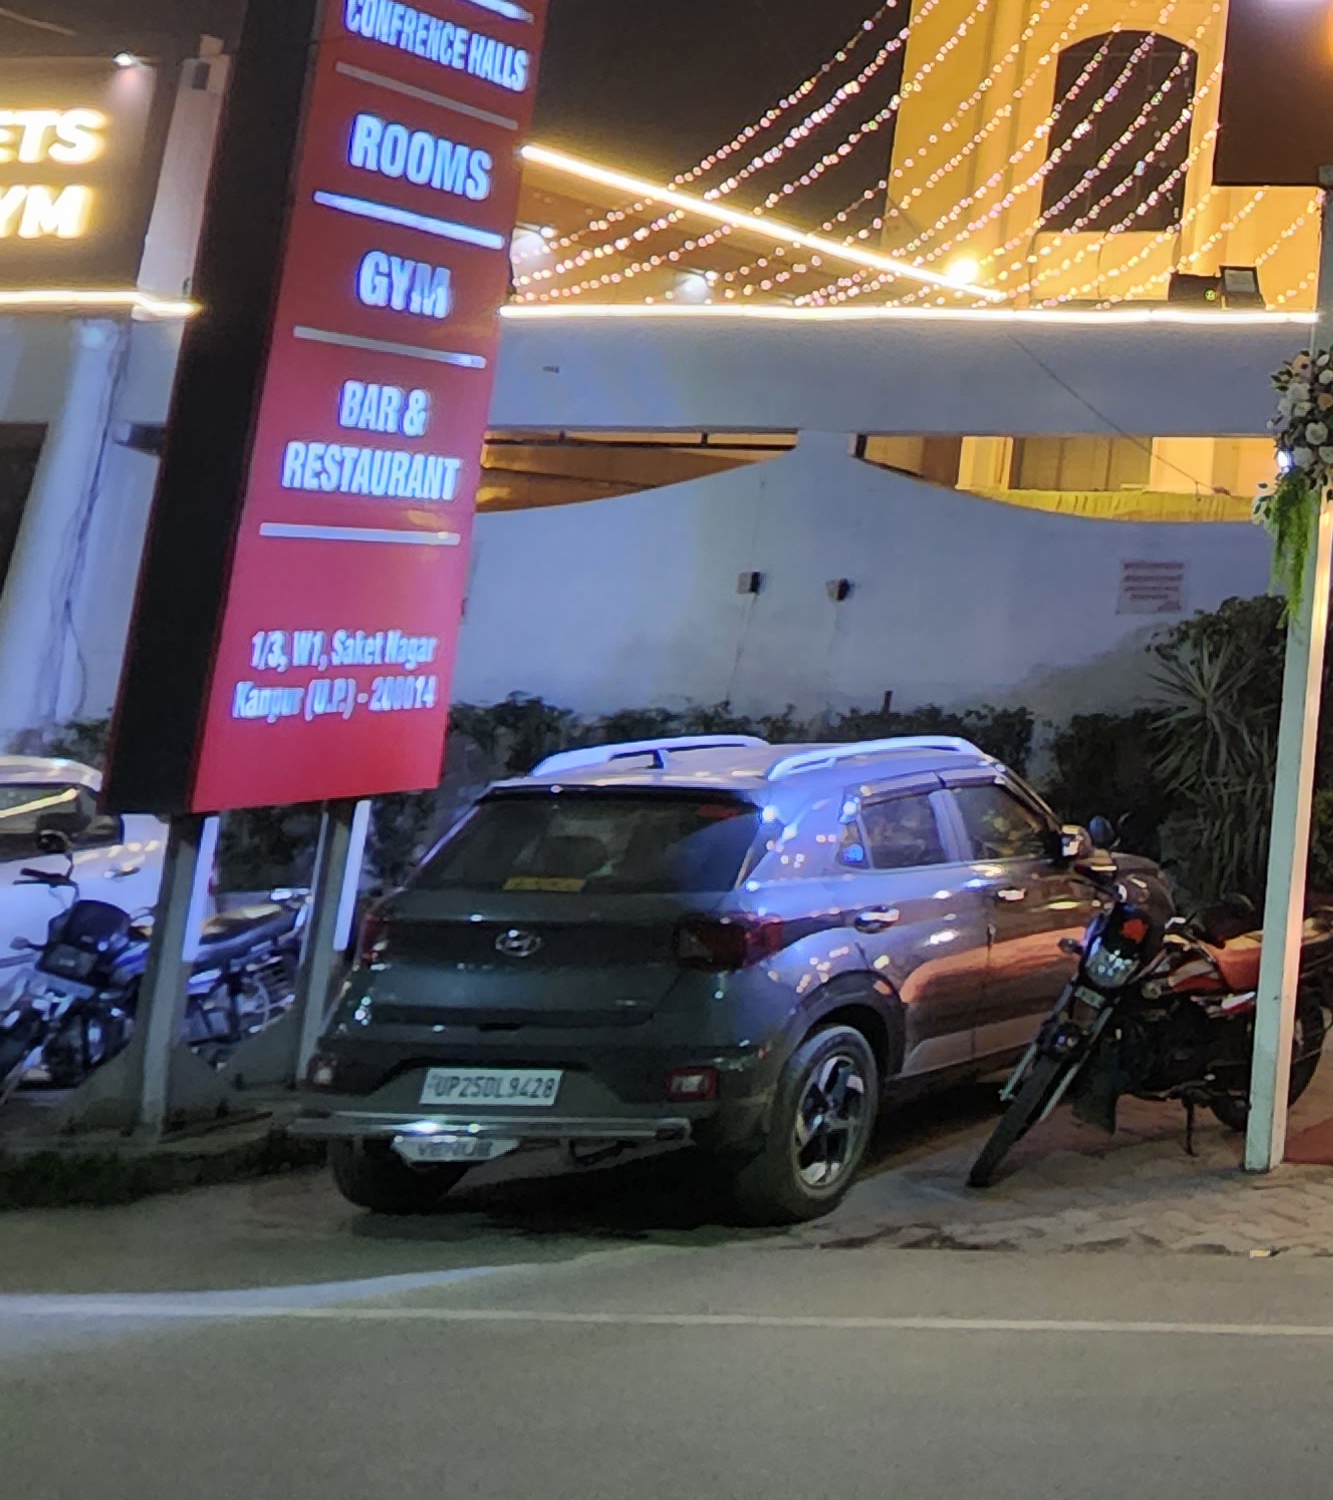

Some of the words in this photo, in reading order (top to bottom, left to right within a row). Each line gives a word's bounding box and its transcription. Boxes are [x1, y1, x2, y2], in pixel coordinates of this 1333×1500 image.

[467, 32, 529, 92] HALLS
[349, 113, 492, 201] ROOMS
[358, 250, 452, 319] GYM
[339, 379, 400, 433] BAR
[403, 388, 428, 437] &
[281, 440, 460, 500] RESTAURANT
[331, 629, 384, 666] Saket
[385, 629, 436, 670] Nagar
[231, 681, 305, 723] Kanpur
